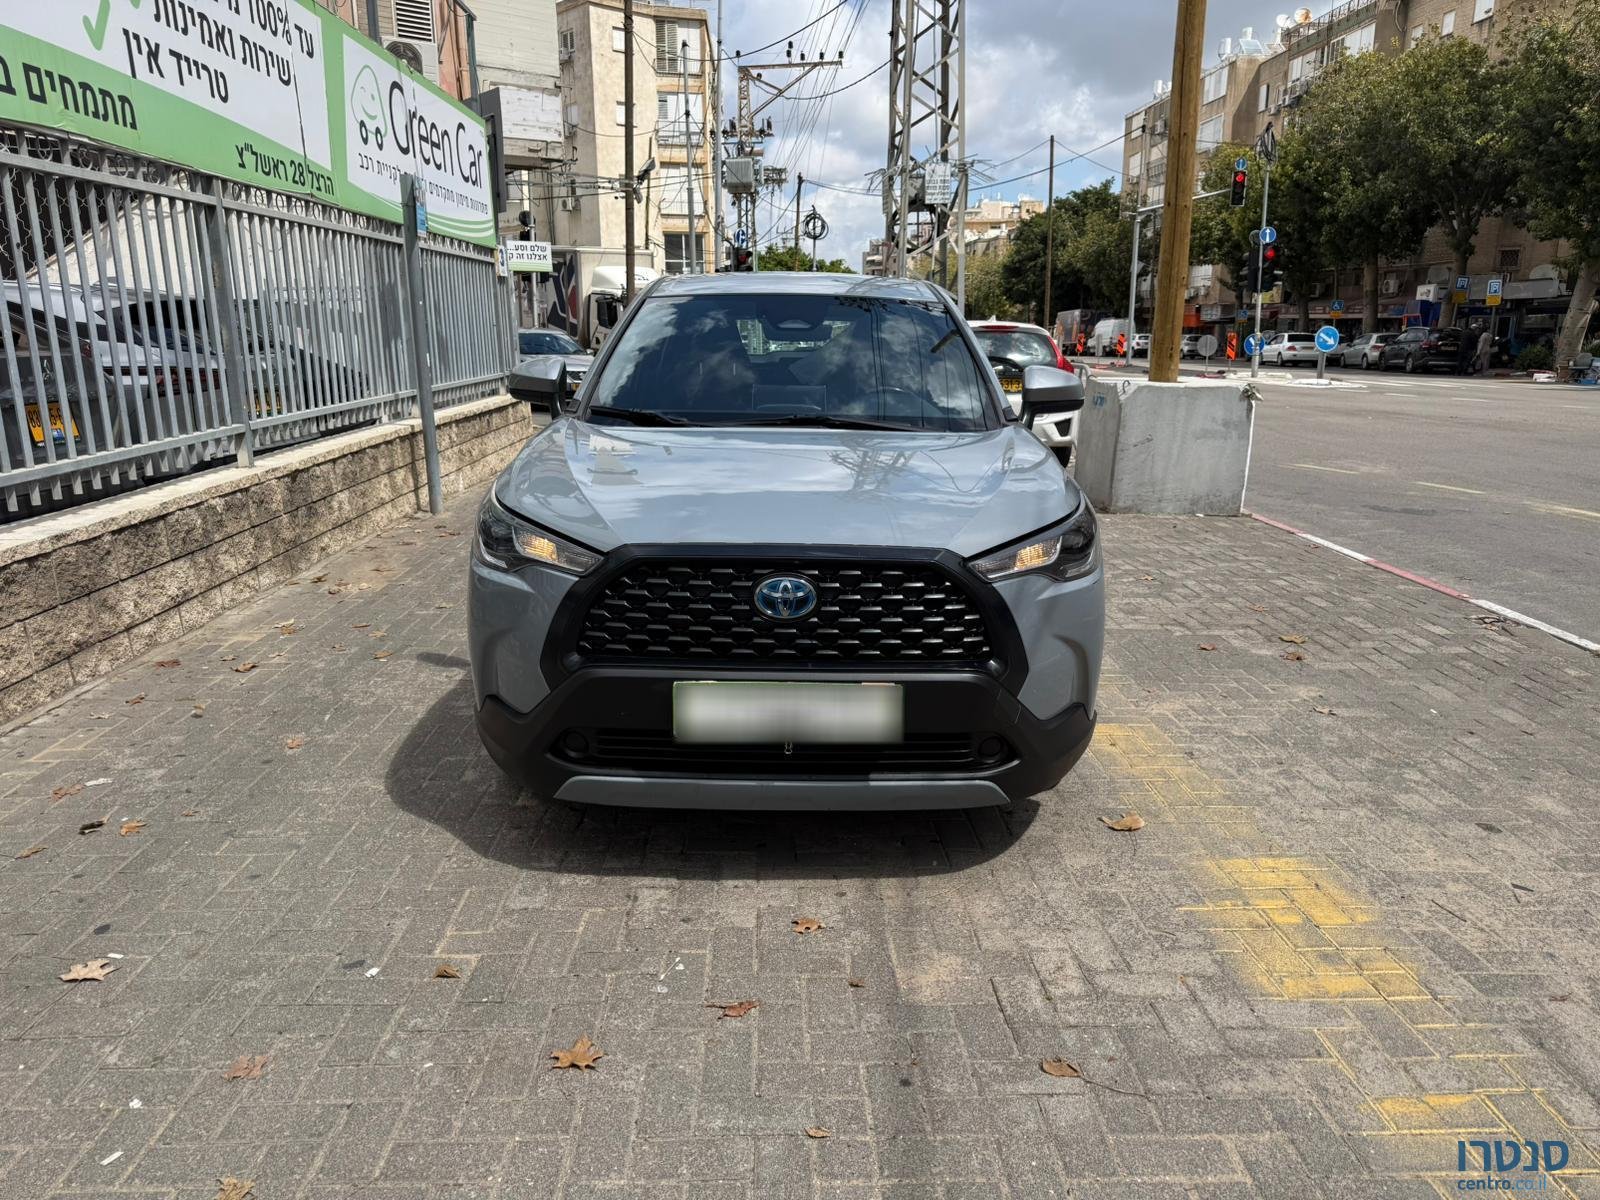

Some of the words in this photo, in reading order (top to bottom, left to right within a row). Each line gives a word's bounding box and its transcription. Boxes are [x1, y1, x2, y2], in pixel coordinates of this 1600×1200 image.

[154, 0, 236, 60] ואמינות
[248, 0, 292, 46] 100%
[294, 23, 314, 59] עד
[122, 27, 165, 80] אין
[240, 34, 291, 87] שירות
[22, 62, 138, 131] מתמחים
[169, 48, 229, 104] טרייד
[389, 80, 455, 176] Green
[455, 121, 483, 189] Car
[290, 159, 306, 187] 28
[306, 164, 335, 196] הרצל
[358, 152, 375, 173] רכב
[516, 252, 524, 260] זה
[527, 252, 548, 262] אצלנו
[530, 243, 547, 253] שלם
